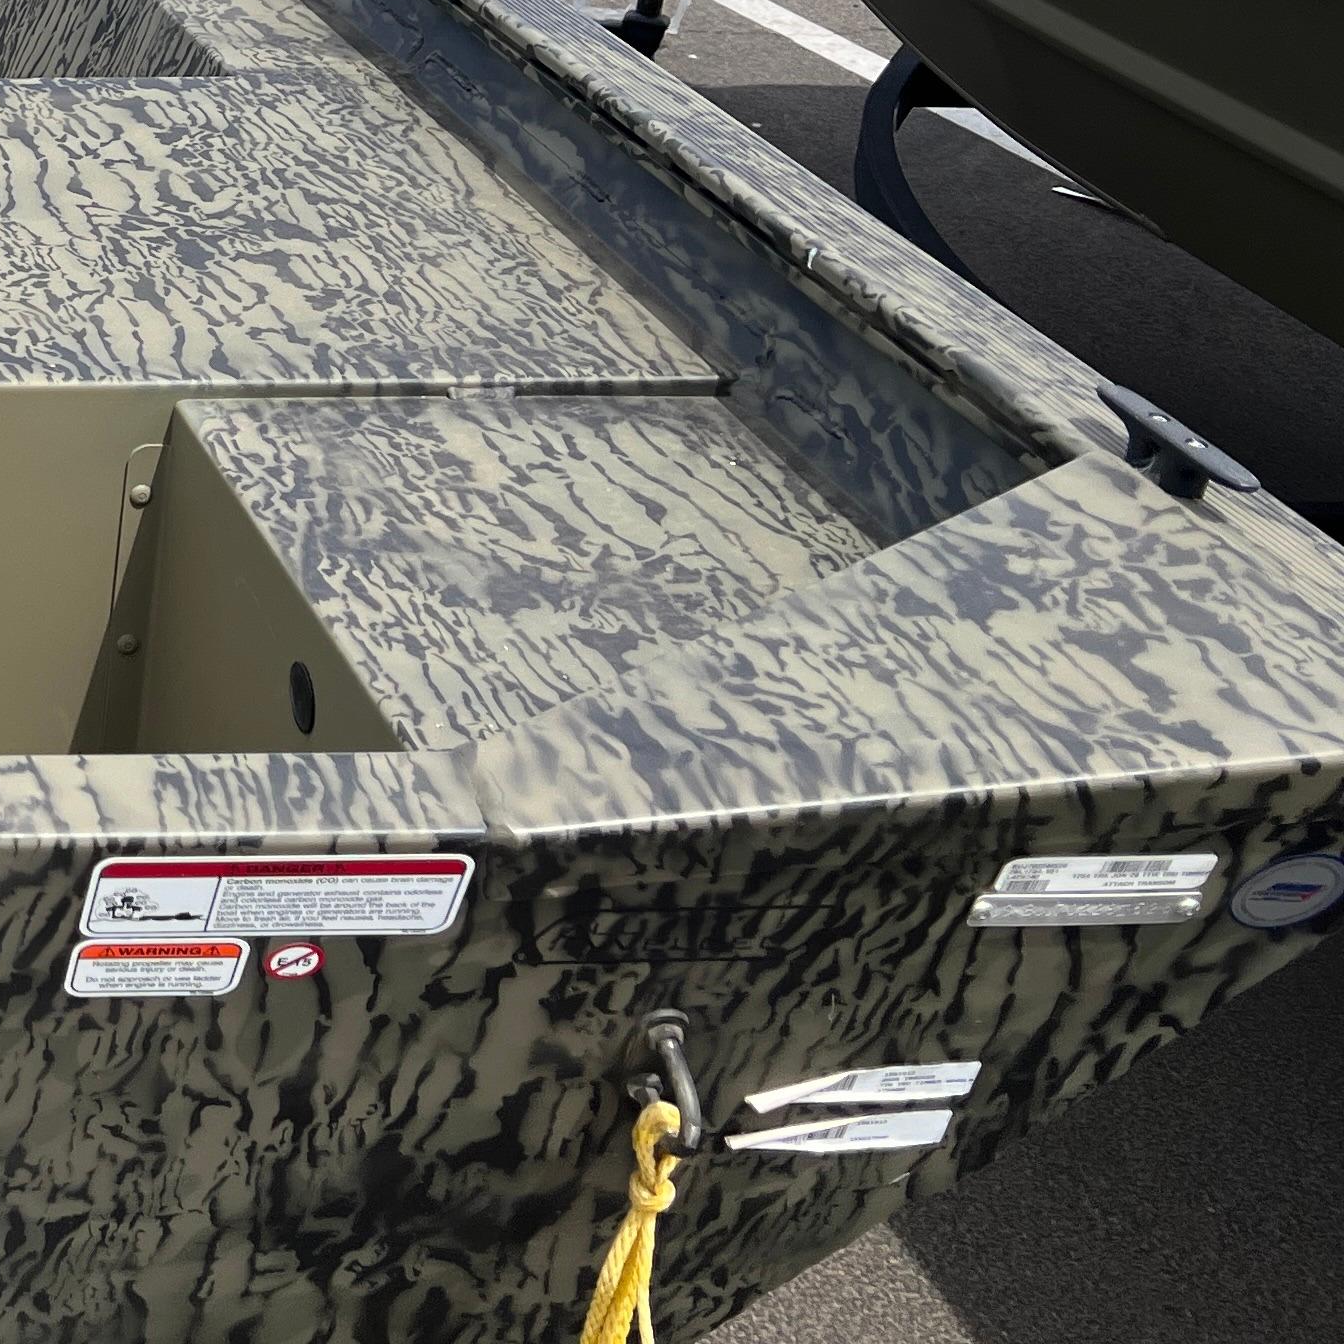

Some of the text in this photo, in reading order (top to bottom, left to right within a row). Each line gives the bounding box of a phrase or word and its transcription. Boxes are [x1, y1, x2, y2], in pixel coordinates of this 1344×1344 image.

[246, 863, 326, 874] DANGER
[315, 877, 339, 885] (CO)
[118, 947, 202, 956] WARNING
